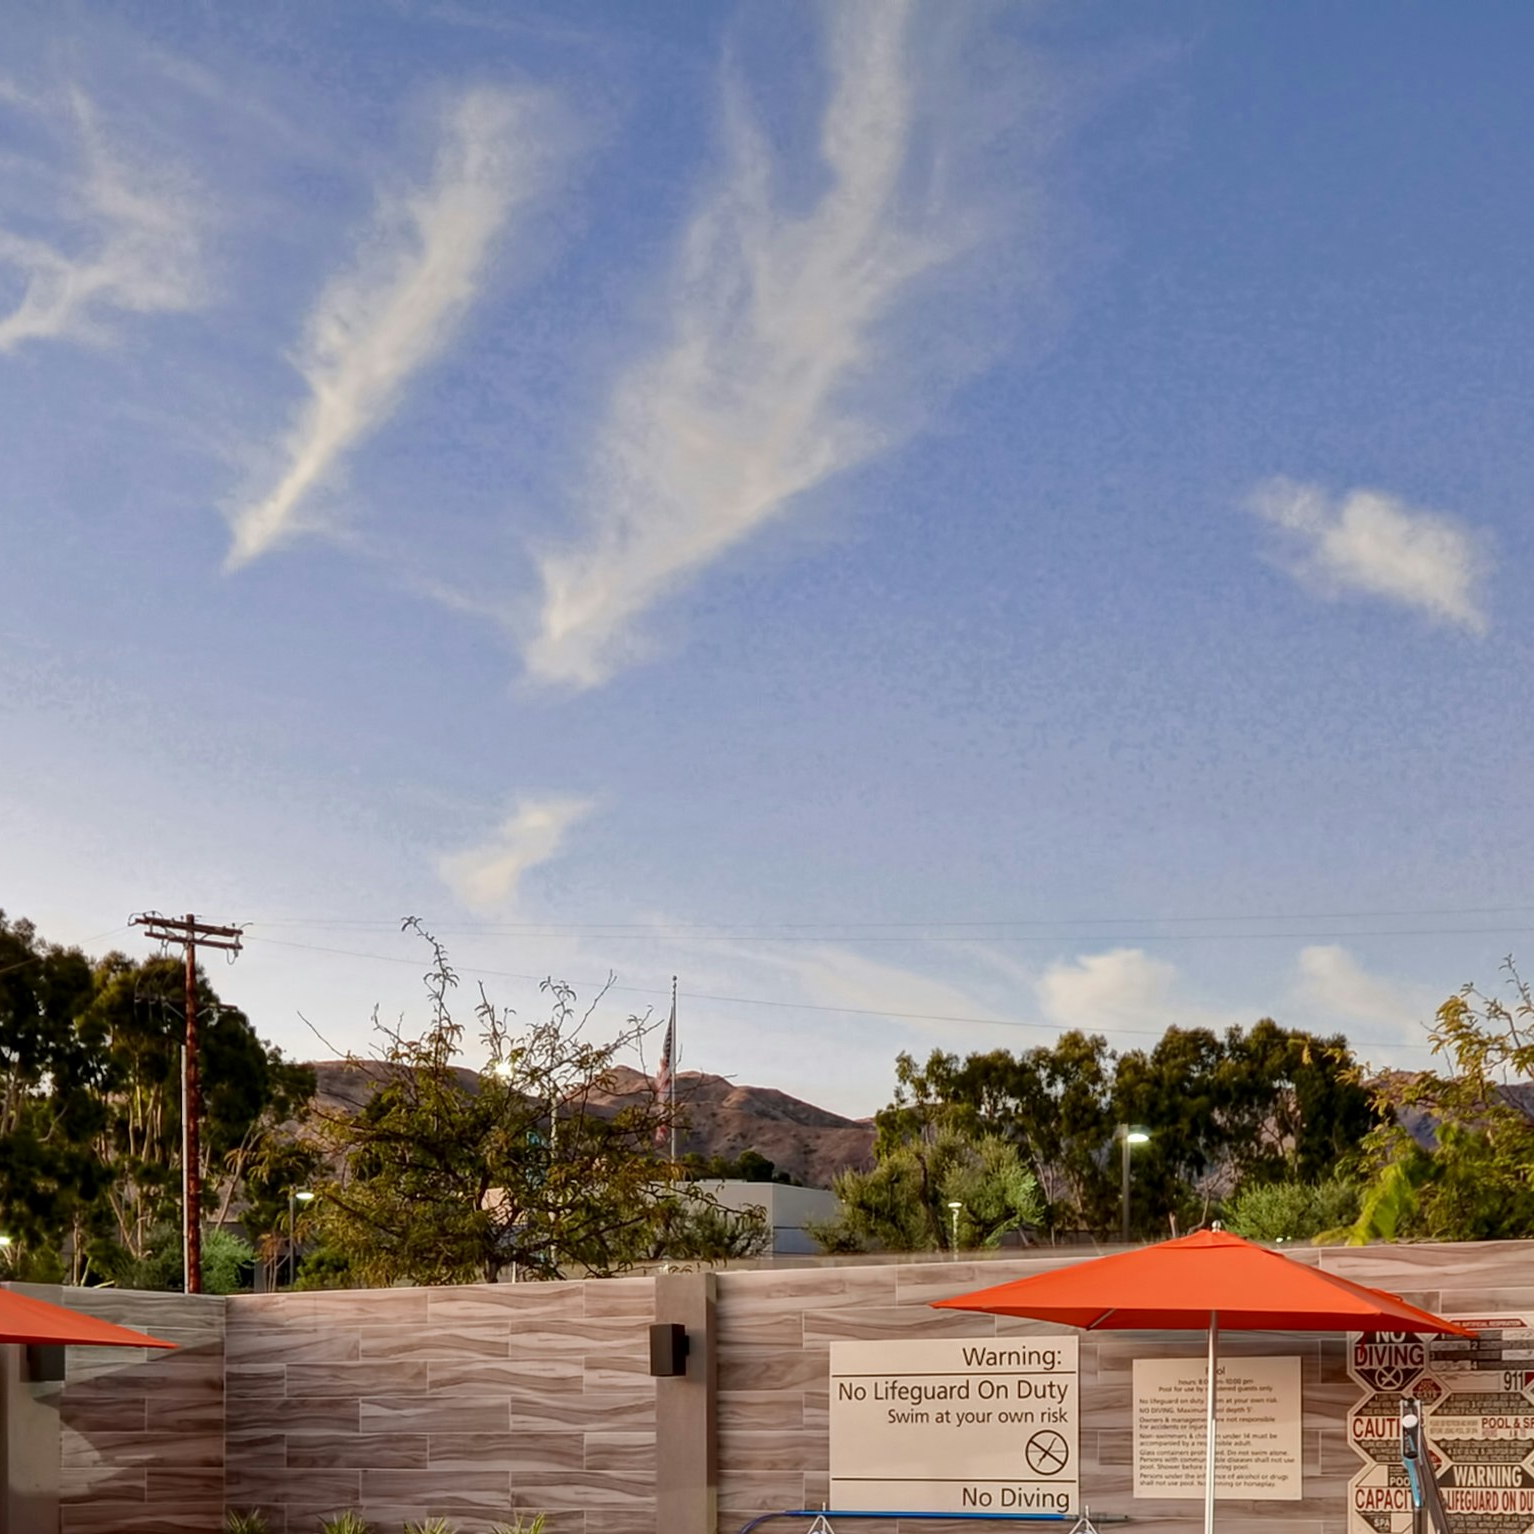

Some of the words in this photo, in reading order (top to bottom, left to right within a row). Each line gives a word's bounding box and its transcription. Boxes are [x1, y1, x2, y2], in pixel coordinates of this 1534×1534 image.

[962, 1346, 1062, 1370] Warning:
[1355, 1345, 1424, 1366] DIVING
[1504, 1372, 1524, 1391] 911
[839, 1383, 866, 1400] No
[874, 1380, 970, 1404] Lifeguard
[978, 1380, 1008, 1399] On
[1018, 1380, 1068, 1404] Duty
[888, 1409, 929, 1424] Swim
[935, 1410, 951, 1423] at
[956, 1411, 992, 1427] your
[998, 1411, 1034, 1423] own
[1040, 1408, 1068, 1423] risk
[1482, 1418, 1511, 1428] POOL
[1513, 1418, 1521, 1428] &
[1353, 1418, 1400, 1438] CAUTI
[1390, 1477, 1411, 1486] POO
[1453, 1466, 1522, 1486] WARNING
[962, 1488, 991, 1506] No
[1001, 1488, 1069, 1512] Diving
[1355, 1489, 1412, 1509] CAPACI
[1447, 1490, 1499, 1510] LIFEGUARD
[1502, 1491, 1516, 1511] ON
[1373, 1519, 1391, 1528] SPA
